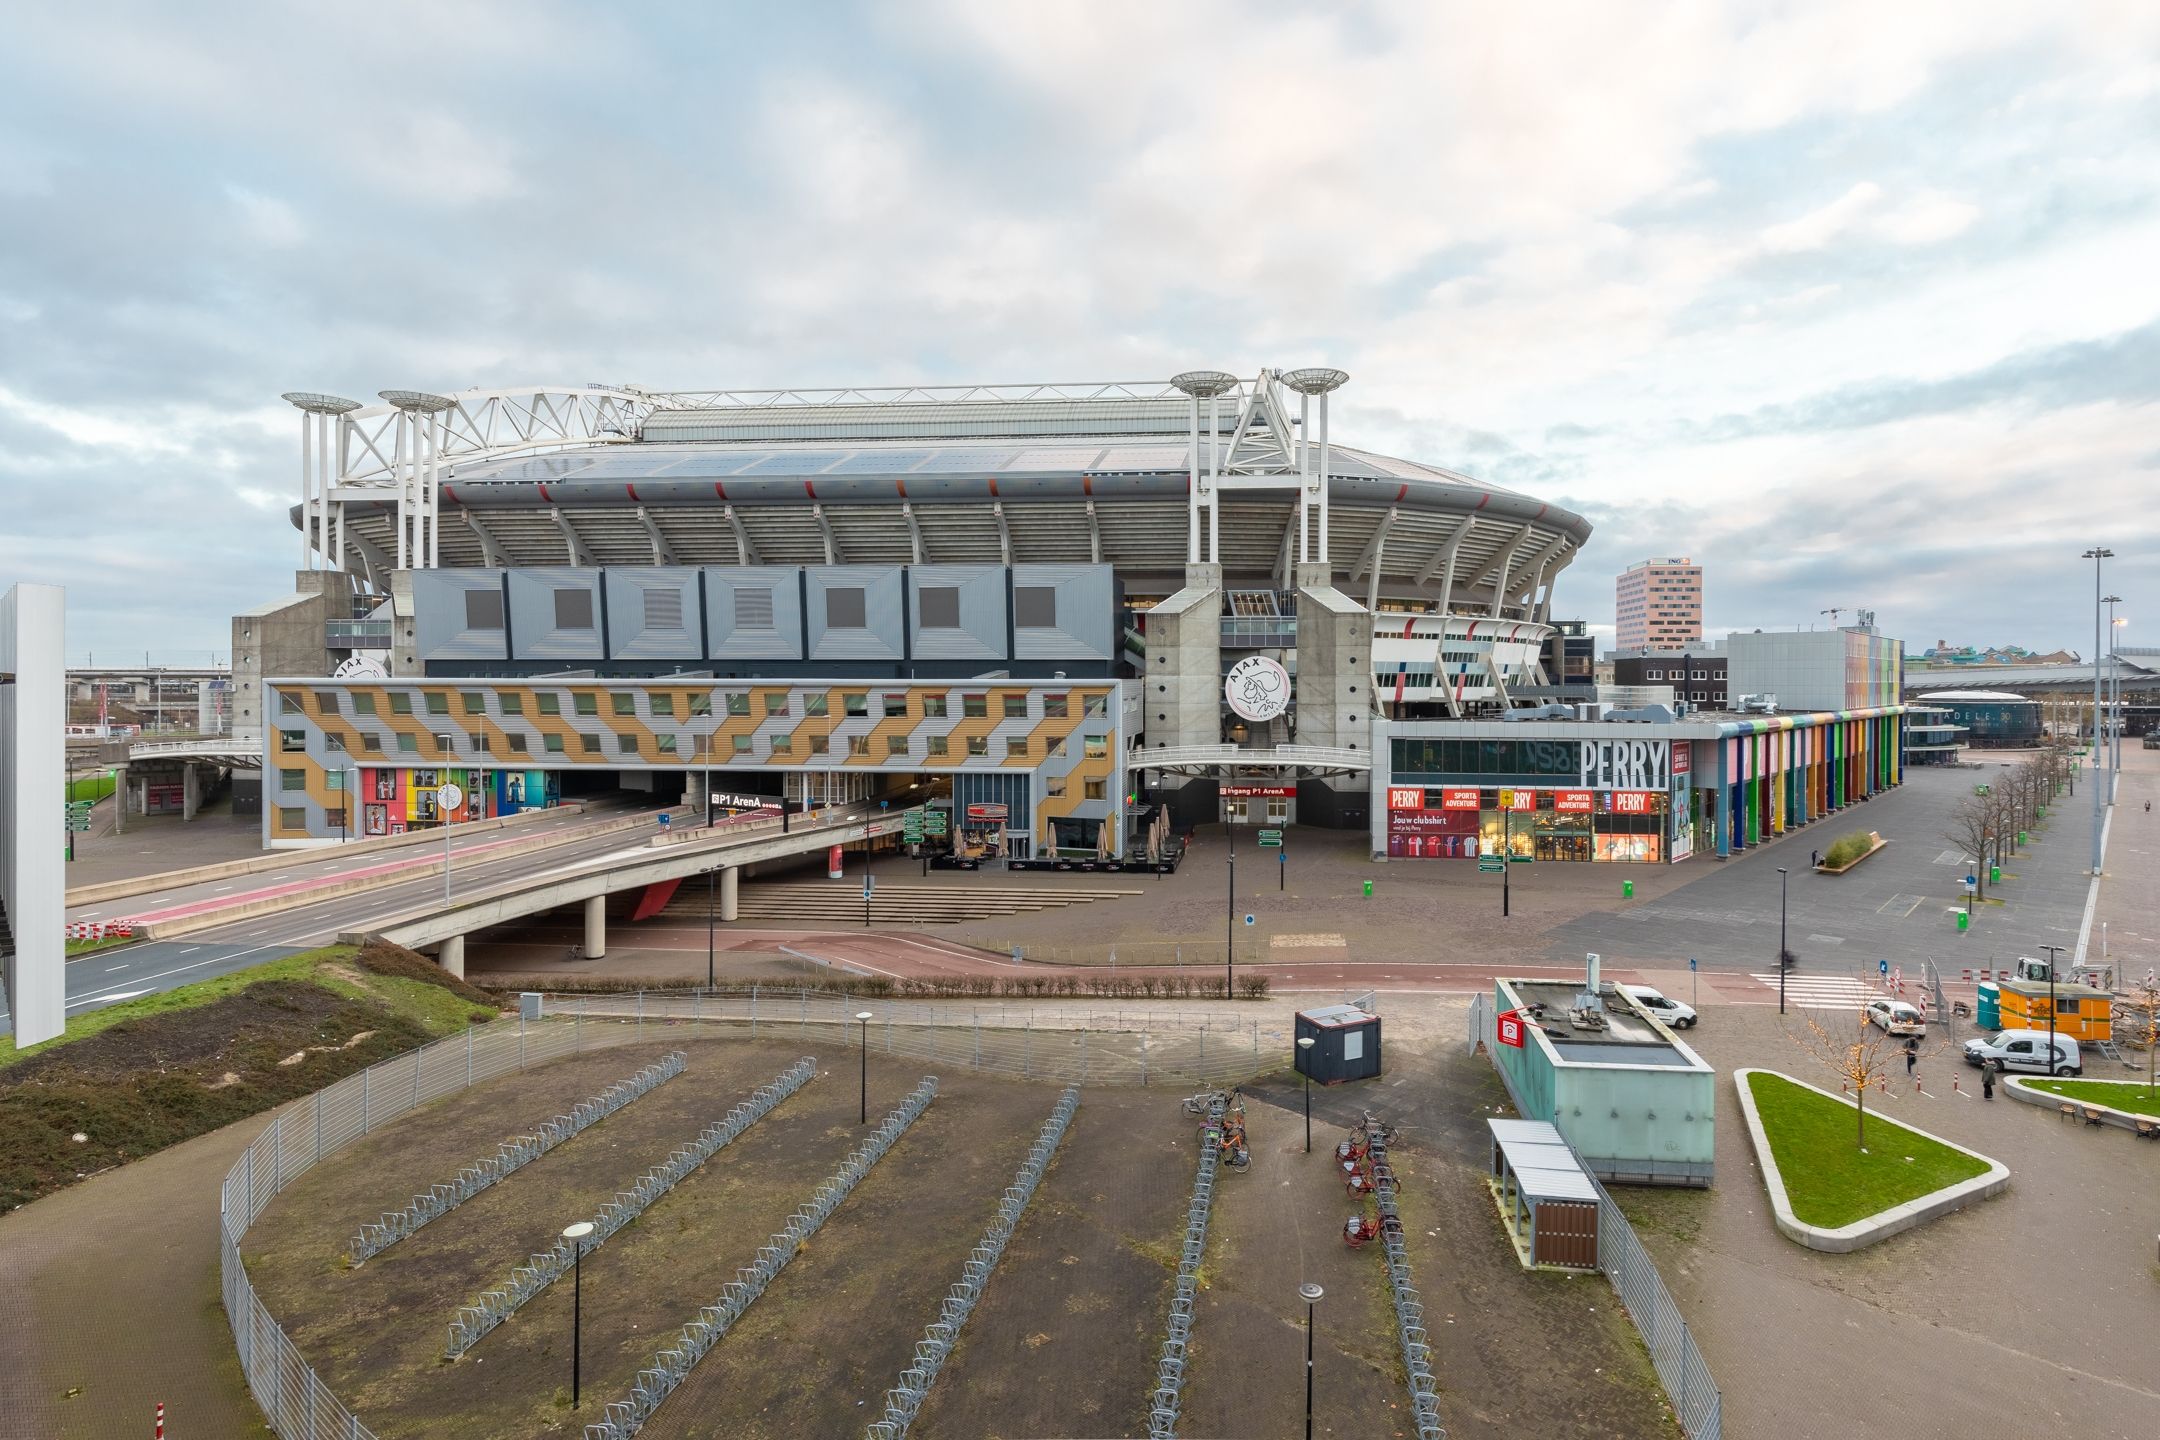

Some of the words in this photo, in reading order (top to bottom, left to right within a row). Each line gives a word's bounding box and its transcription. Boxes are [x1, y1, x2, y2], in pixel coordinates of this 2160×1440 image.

[1230, 658, 1260, 683] AJAX
[1581, 739, 1666, 790] PERRY
[1227, 787, 1251, 796] Ingang
[1392, 790, 1420, 808] PERRY
[719, 794, 731, 805] P1
[732, 796, 761, 807] ArenA
[1617, 794, 1645, 811] PERRY
[1393, 814, 1413, 824] Jouw
[1413, 815, 1447, 825] clubshirt
